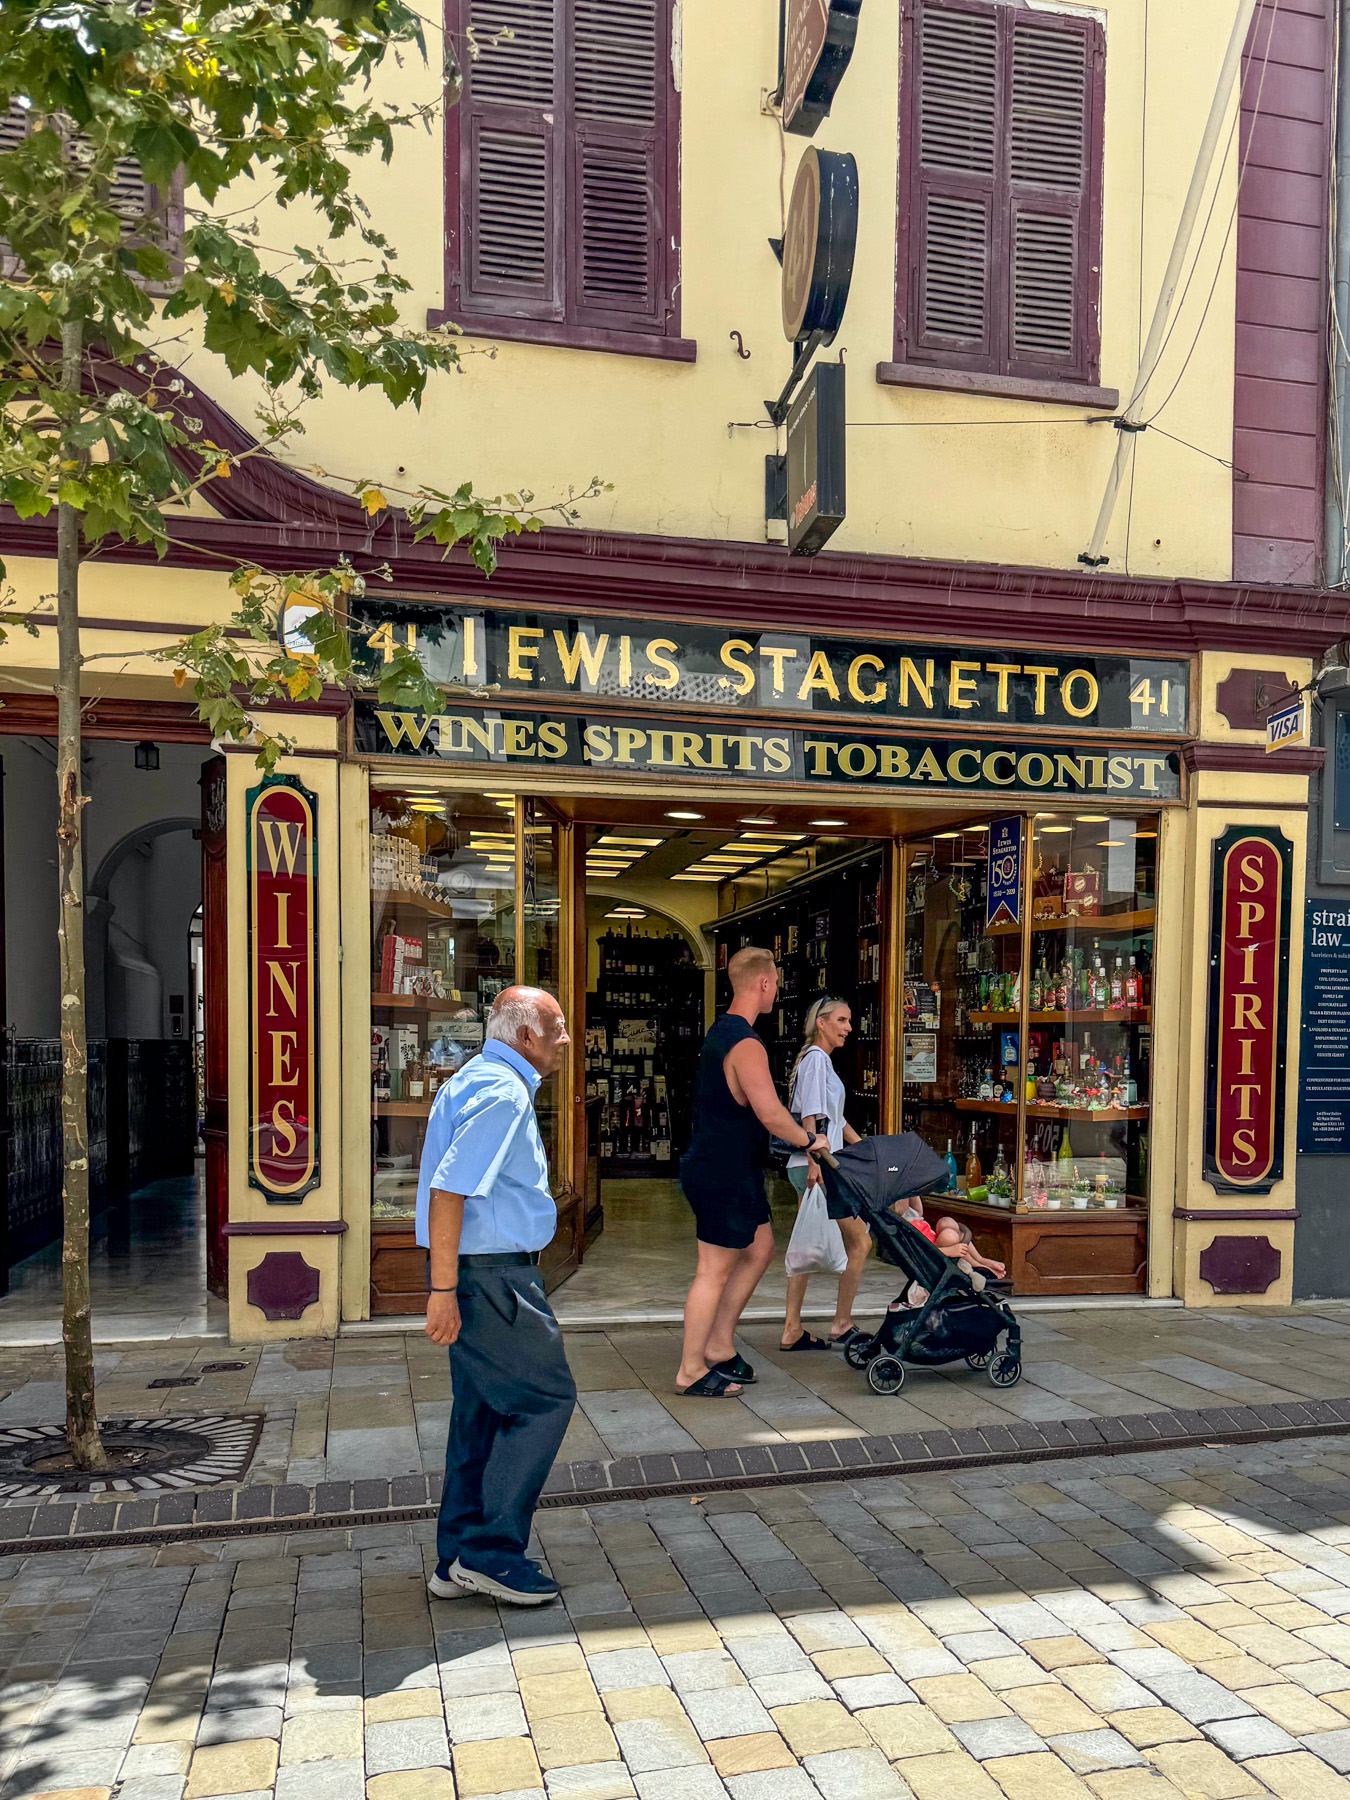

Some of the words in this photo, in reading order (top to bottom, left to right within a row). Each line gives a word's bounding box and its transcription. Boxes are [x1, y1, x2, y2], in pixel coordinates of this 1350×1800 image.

[366, 621, 417, 664] 41
[717, 638, 1099, 719] STAGNETTO
[1128, 678, 1169, 717] 41
[373, 710, 569, 758] WINES
[584, 724, 791, 773] SPIRITS
[803, 740, 1165, 792] TOBACCONIST
[1271, 713, 1299, 743] VISA
[992, 845, 1017, 856] STAGNETTO
[1311, 927, 1343, 947] law
[259, 820, 304, 1158] WINES
[1229, 854, 1267, 1167] SPIRITS
